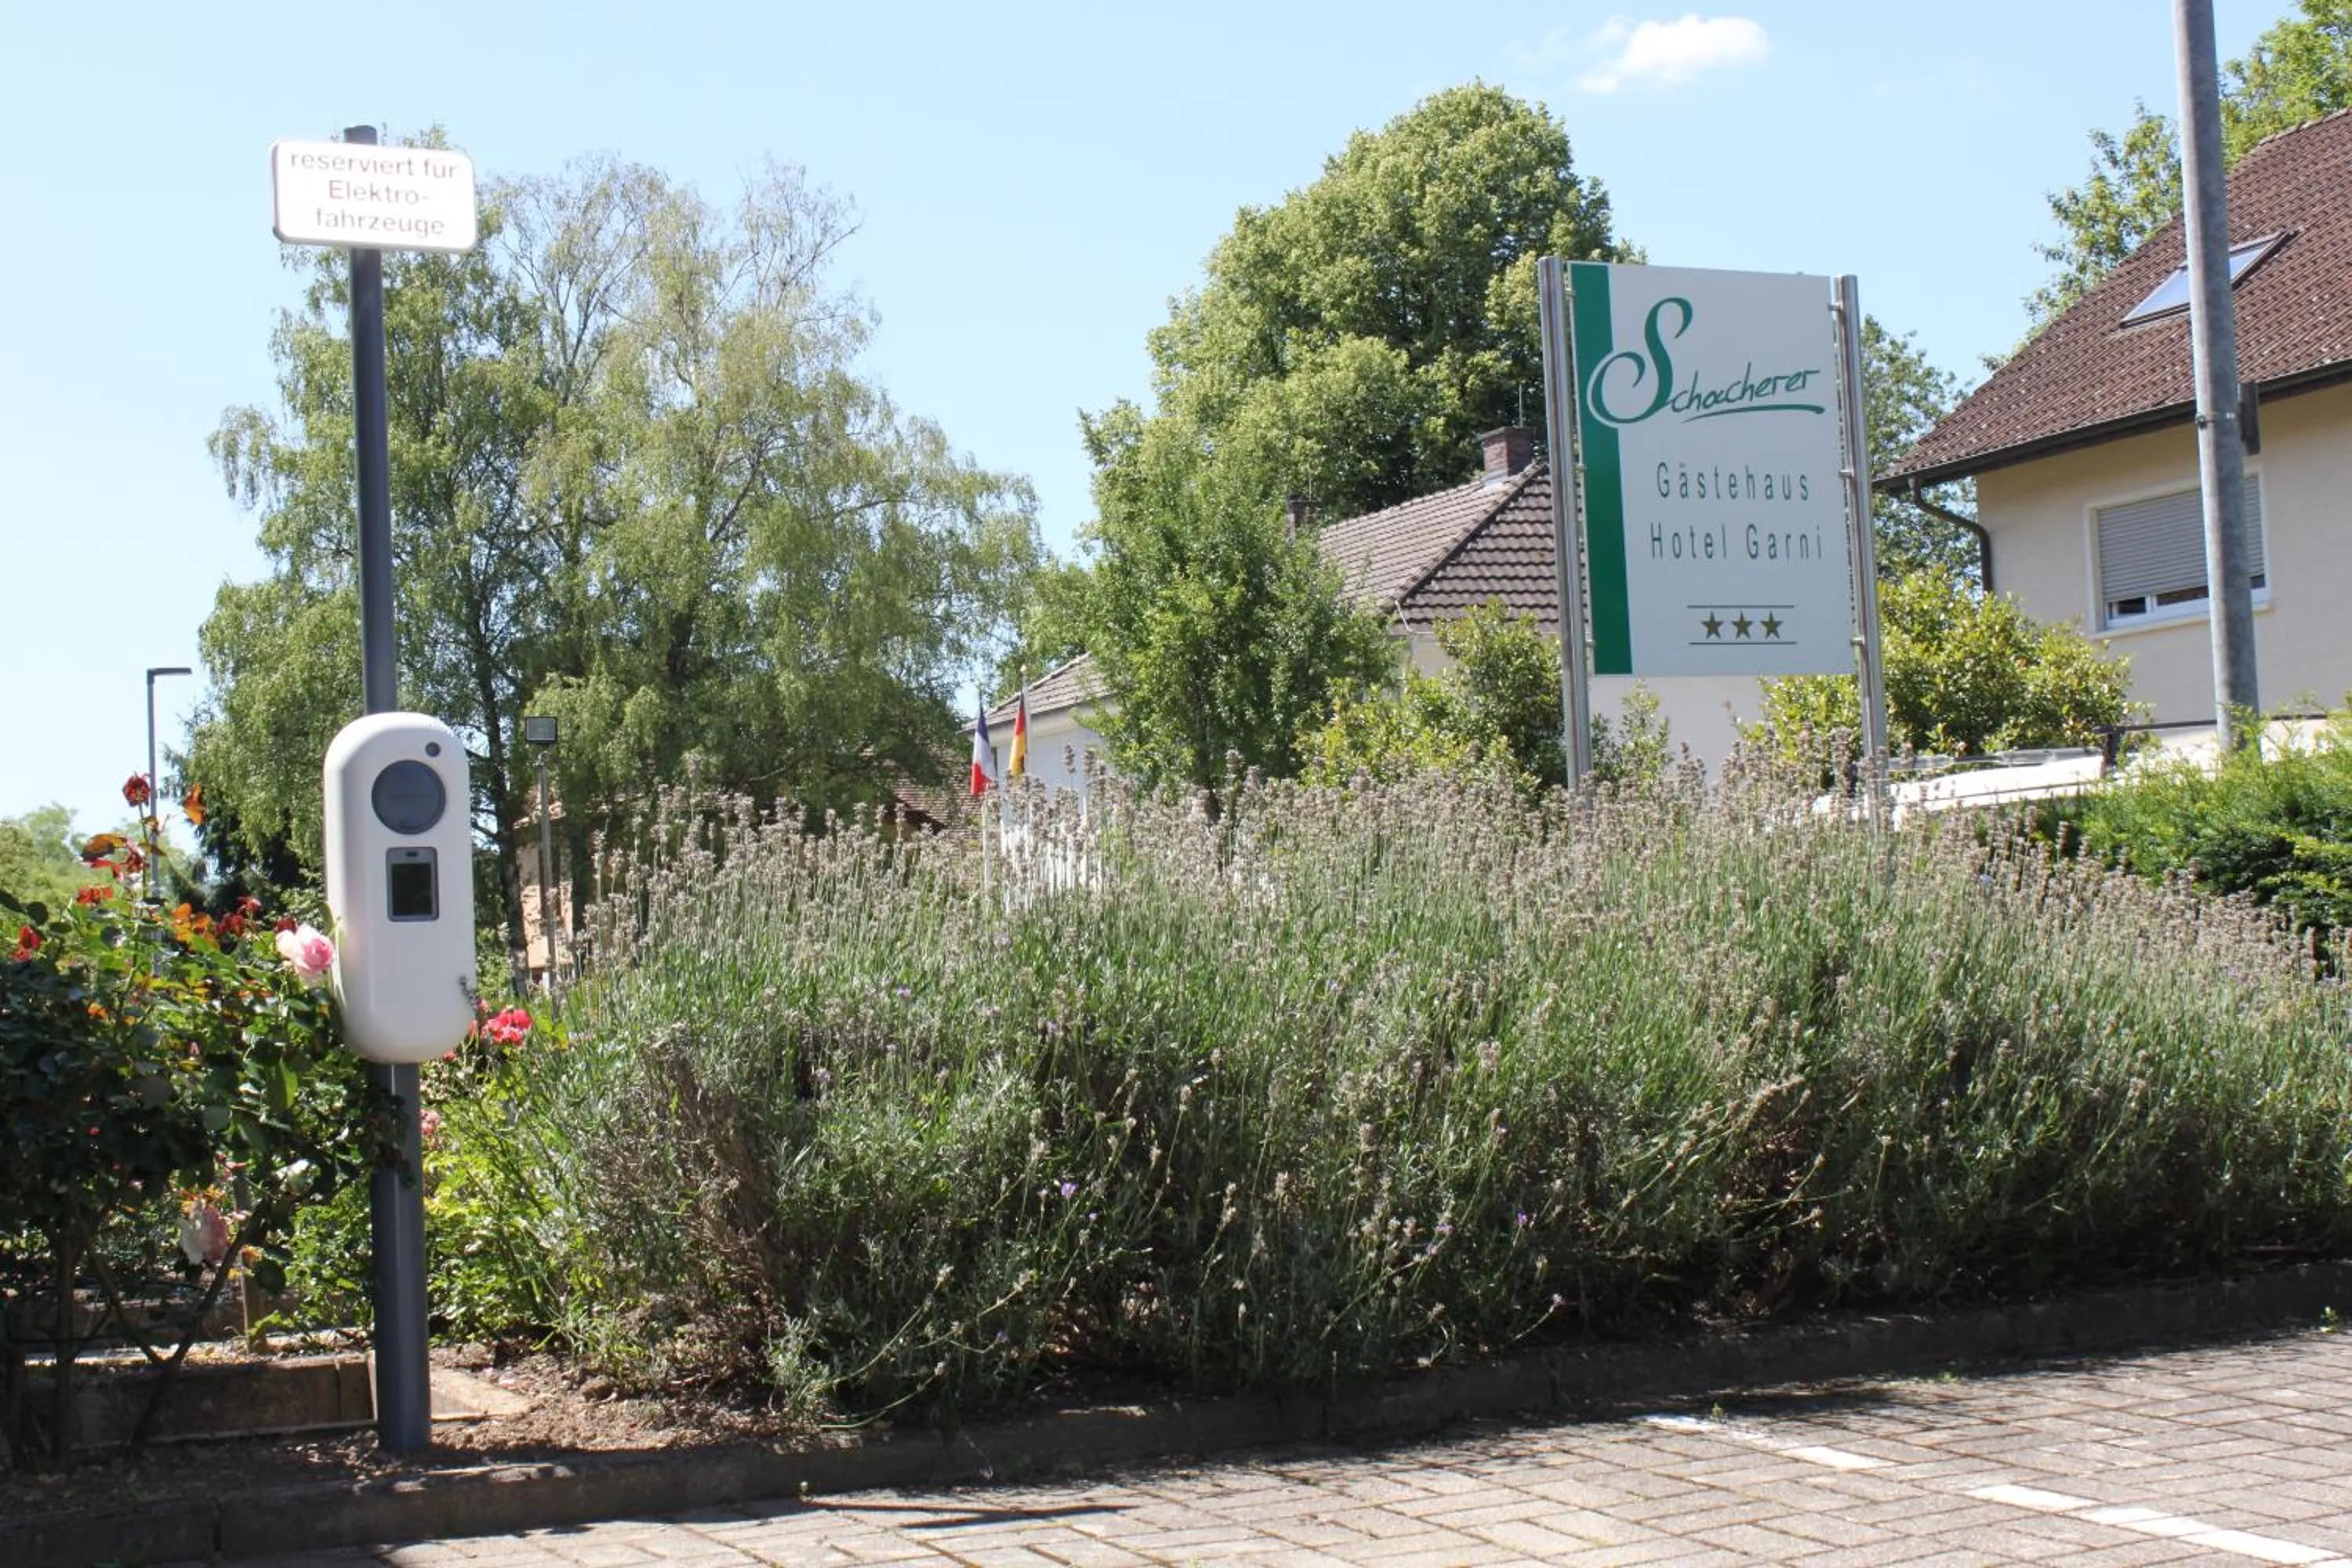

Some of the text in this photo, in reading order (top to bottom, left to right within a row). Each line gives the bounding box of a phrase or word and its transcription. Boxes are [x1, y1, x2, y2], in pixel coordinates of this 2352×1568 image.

[291, 153, 415, 176] reserviert
[328, 180, 430, 205] Elektro-
[315, 207, 445, 238] fahrzeuge
[1591, 297, 1821, 423] Schacherer
[1656, 461, 1809, 500] Gästehaus
[1650, 521, 1822, 561] Hotel Garni
